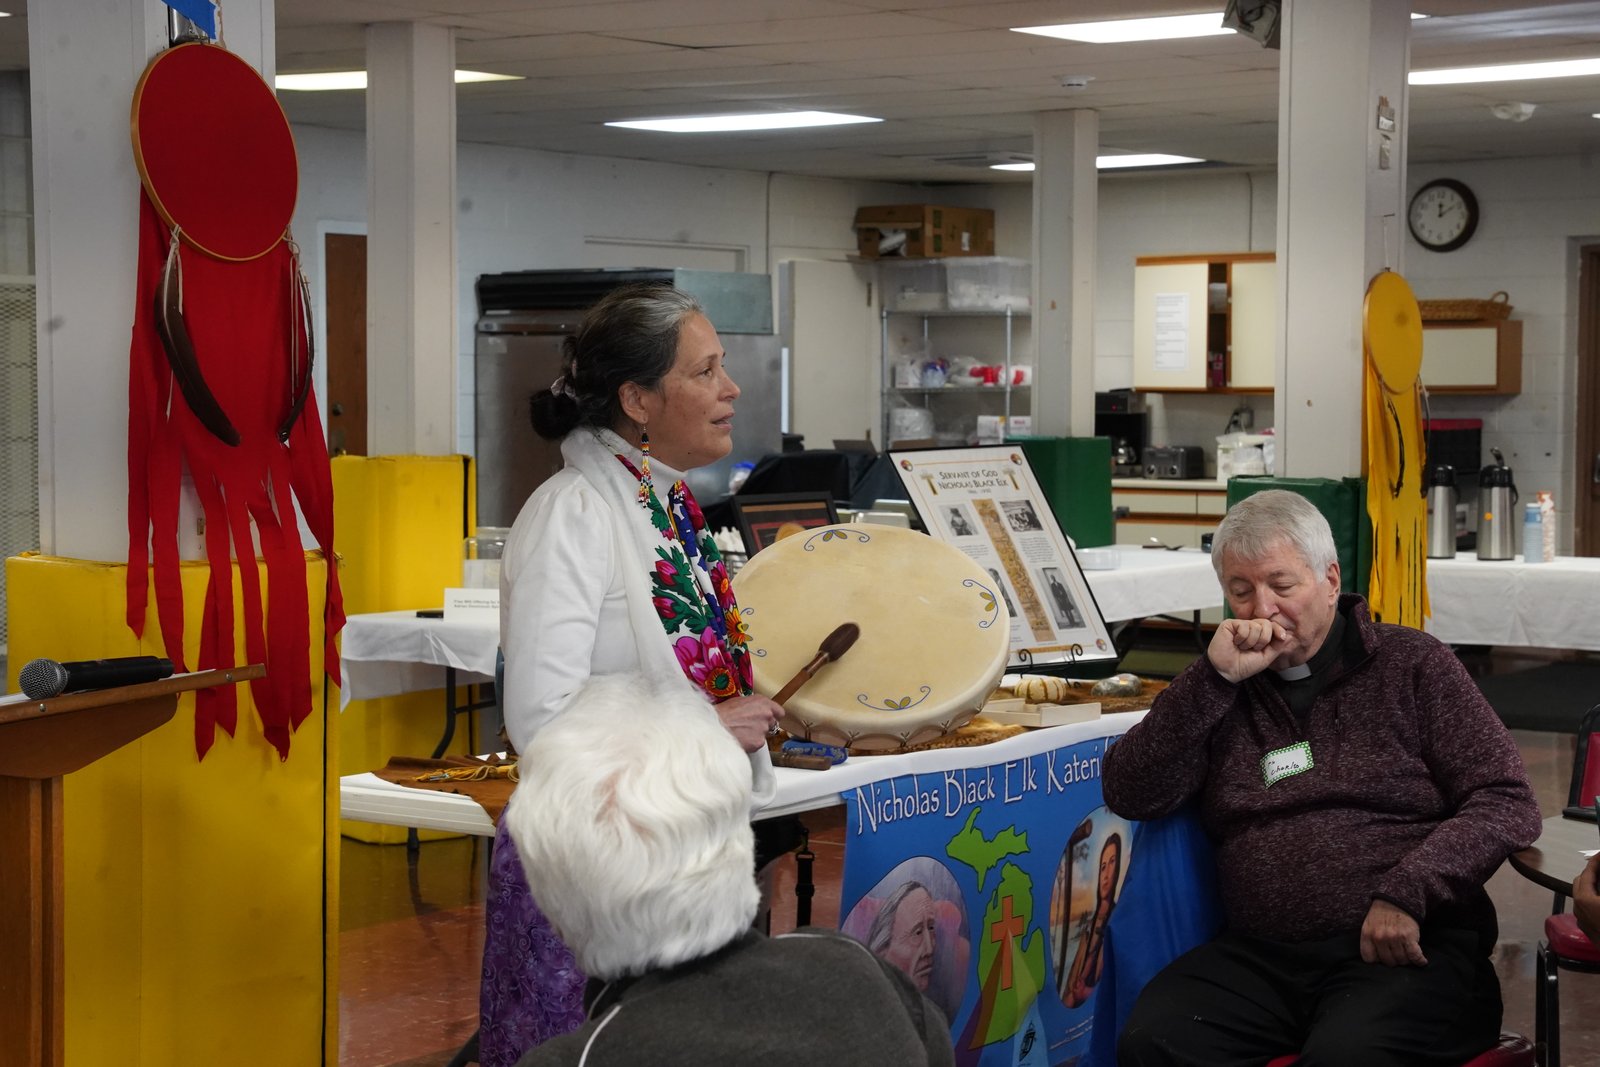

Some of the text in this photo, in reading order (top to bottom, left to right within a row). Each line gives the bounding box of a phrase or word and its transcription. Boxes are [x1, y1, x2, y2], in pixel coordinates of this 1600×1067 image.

[857, 744, 1100, 836] Nicholas Black Elk Kateri
